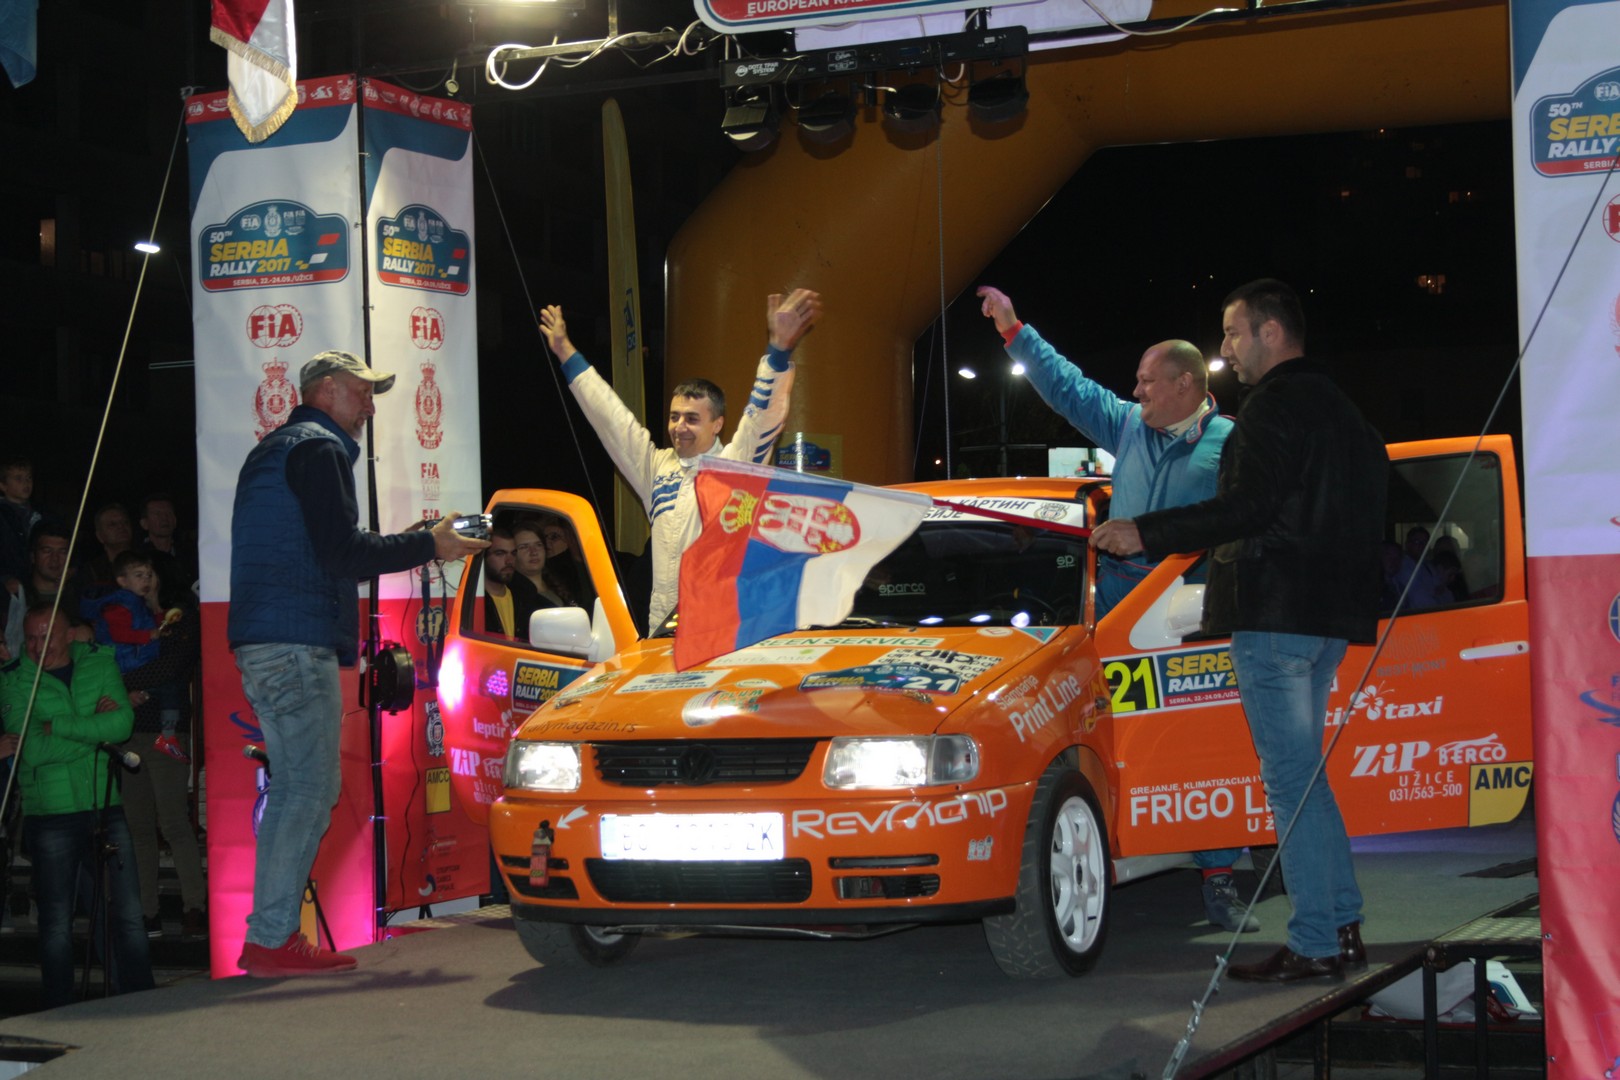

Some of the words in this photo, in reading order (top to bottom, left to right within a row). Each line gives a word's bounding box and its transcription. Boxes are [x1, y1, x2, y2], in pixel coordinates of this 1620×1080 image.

[1547, 137, 1618, 159] RALLY
[209, 238, 289, 262] SERBIA
[382, 237, 434, 262] SERBIA
[210, 260, 257, 277] RALLY
[256, 258, 291, 273] 2017
[382, 257, 415, 273] RALLY
[414, 262, 436, 276] 2017
[878, 582, 926, 594] sparco
[758, 637, 817, 647] REEN
[823, 637, 940, 647] SERVICE
[516, 665, 560, 689] SERBIA
[902, 676, 957, 691] 21
[1103, 657, 1157, 713] 21
[1167, 672, 1225, 693] RALLY
[514, 685, 541, 700] RALLY
[995, 674, 1039, 711] Stampanja
[1008, 693, 1055, 743] Print
[1044, 674, 1081, 712] Line
[1324, 707, 1356, 726] tir
[1384, 696, 1443, 719] taxi
[473, 716, 506, 739] leptir
[1350, 740, 1431, 778] ZiP
[1438, 746, 1507, 766] BERCO
[1130, 782, 1182, 795] GREJANJE,
[1183, 776, 1251, 790] KLIMATIZACIJA
[1399, 770, 1454, 787] UŽICE
[1130, 787, 1234, 827] FRIGO
